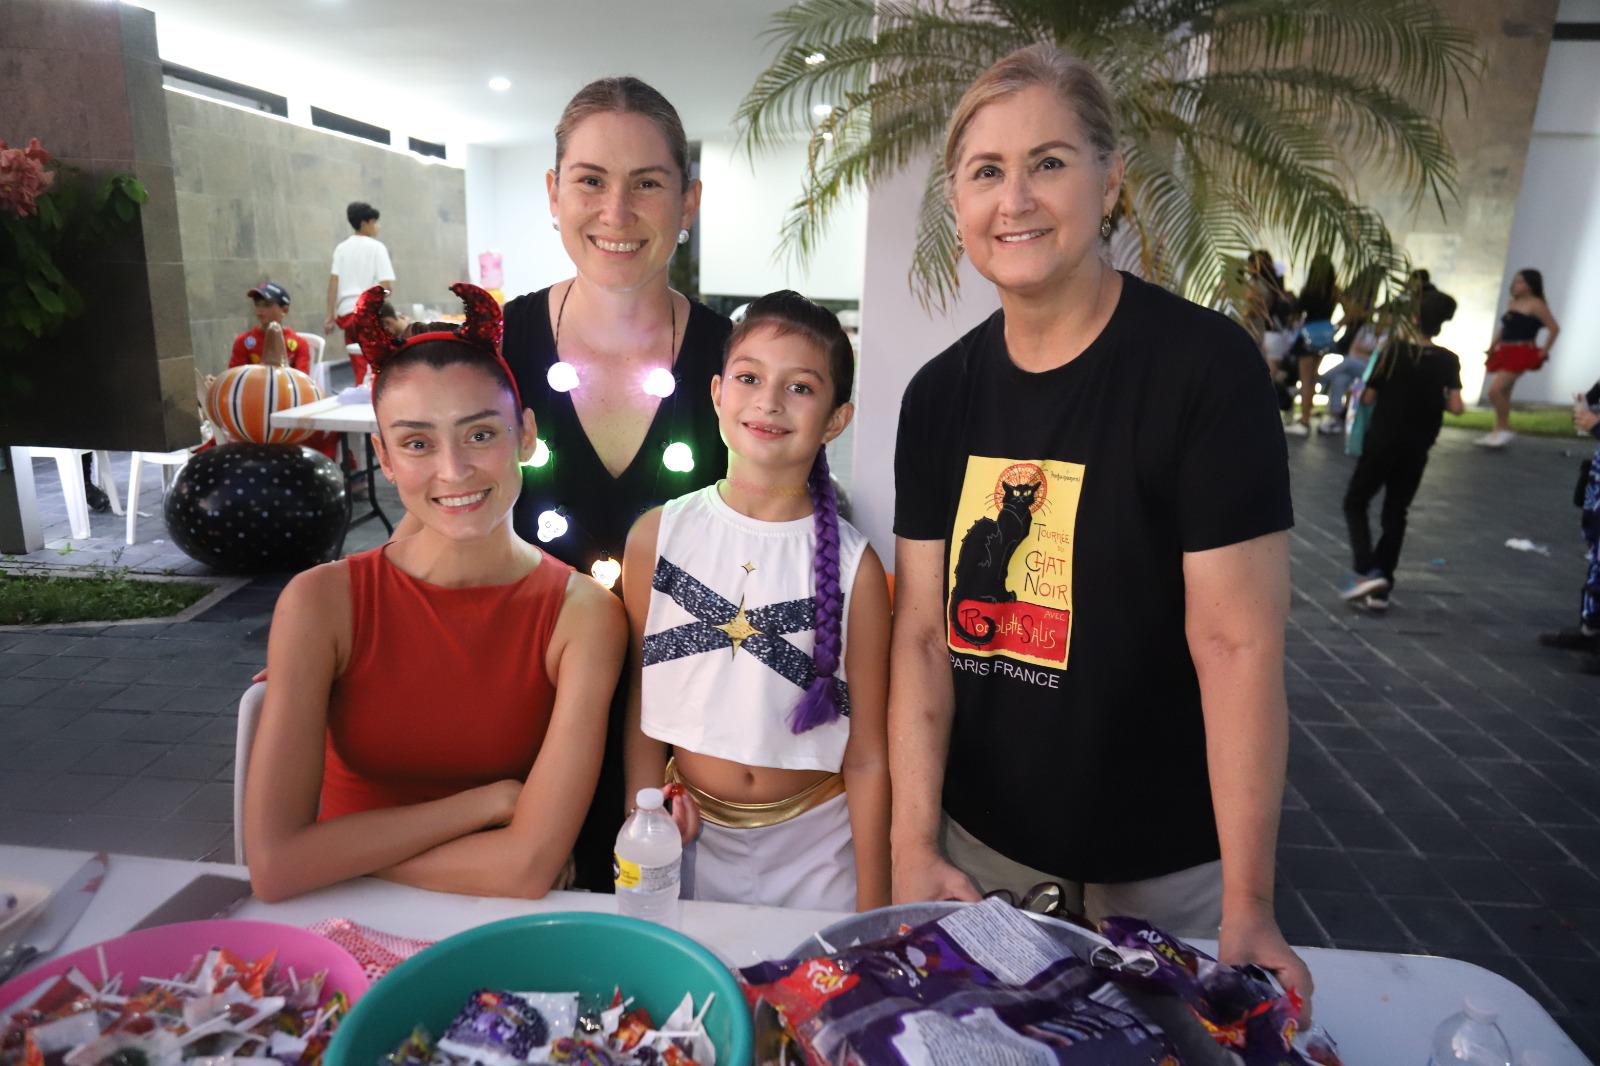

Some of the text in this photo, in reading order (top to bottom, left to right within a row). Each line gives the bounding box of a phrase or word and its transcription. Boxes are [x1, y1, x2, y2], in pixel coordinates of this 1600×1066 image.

[1025, 550, 1066, 578] CHAT
[1024, 572, 1069, 606] NOIR
[1043, 610, 1065, 622] AVEC
[993, 660, 1060, 689] FRANCE
